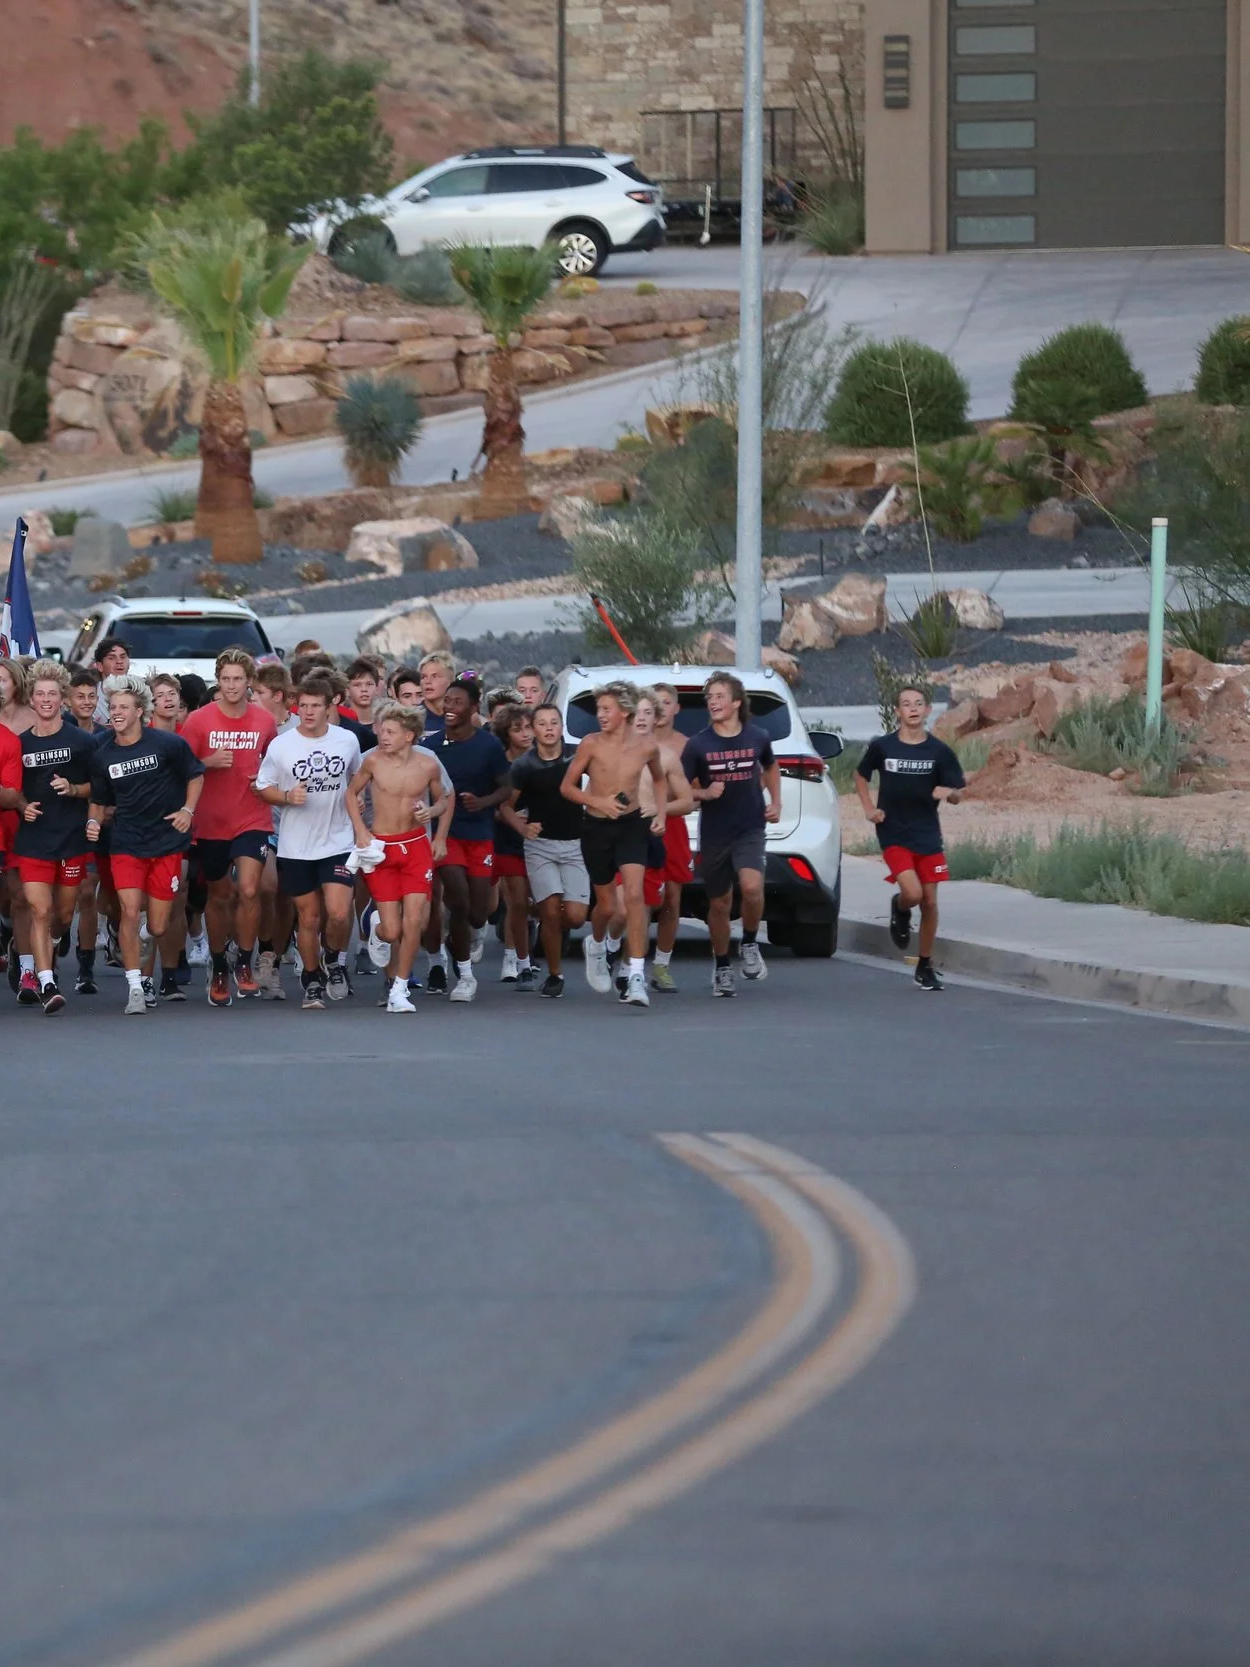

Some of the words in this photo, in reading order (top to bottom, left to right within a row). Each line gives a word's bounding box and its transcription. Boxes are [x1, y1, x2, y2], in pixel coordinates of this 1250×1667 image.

[209, 731, 260, 750] GAMEDAY
[35, 749, 68, 762] CRIMSON
[122, 756, 155, 771] CRIMSON
[898, 761, 933, 769] CRIMSON
